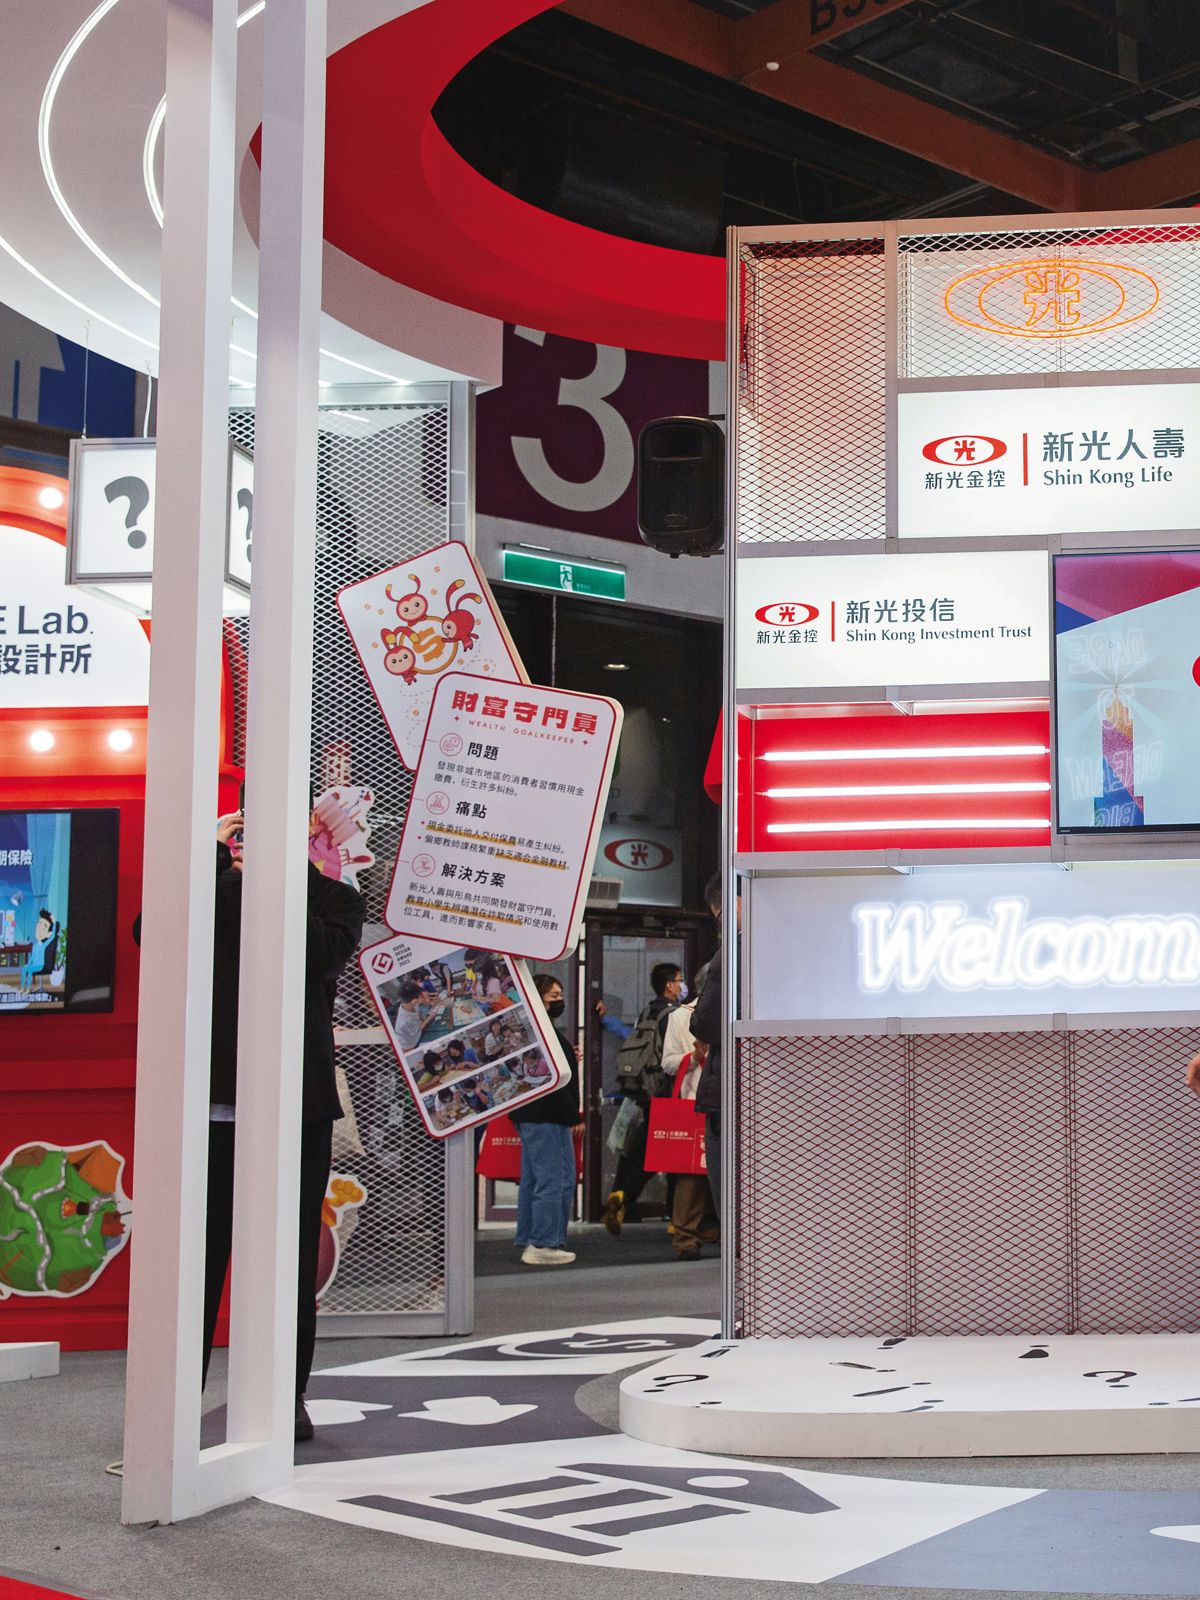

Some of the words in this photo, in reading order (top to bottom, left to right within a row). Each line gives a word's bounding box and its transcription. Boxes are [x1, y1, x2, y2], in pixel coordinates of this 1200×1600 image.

[1023, 270, 1081, 327] 光
[953, 440, 976, 462] 光
[1043, 428, 1184, 462] 新光人壽
[925, 470, 1005, 489] 新光金控
[1044, 468, 1083, 486] Shin
[1090, 468, 1134, 489] Kong
[1142, 466, 1173, 483] Life
[779, 606, 796, 623] 光
[846, 598, 955, 624] 新光投信
[757, 629, 818, 644] 新光金控
[846, 629, 877, 642] Shin
[882, 629, 916, 645] Kong
[921, 627, 995, 640] Investment
[999, 625, 1032, 638] Trust
[452, 690, 598, 736] 財富守門員
[468, 719, 507, 732] WEALTH
[513, 727, 575, 745] GOALKEEPER
[467, 742, 500, 761] 問題
[455, 800, 488, 819] 痛點
[441, 862, 506, 888] 解決方案
